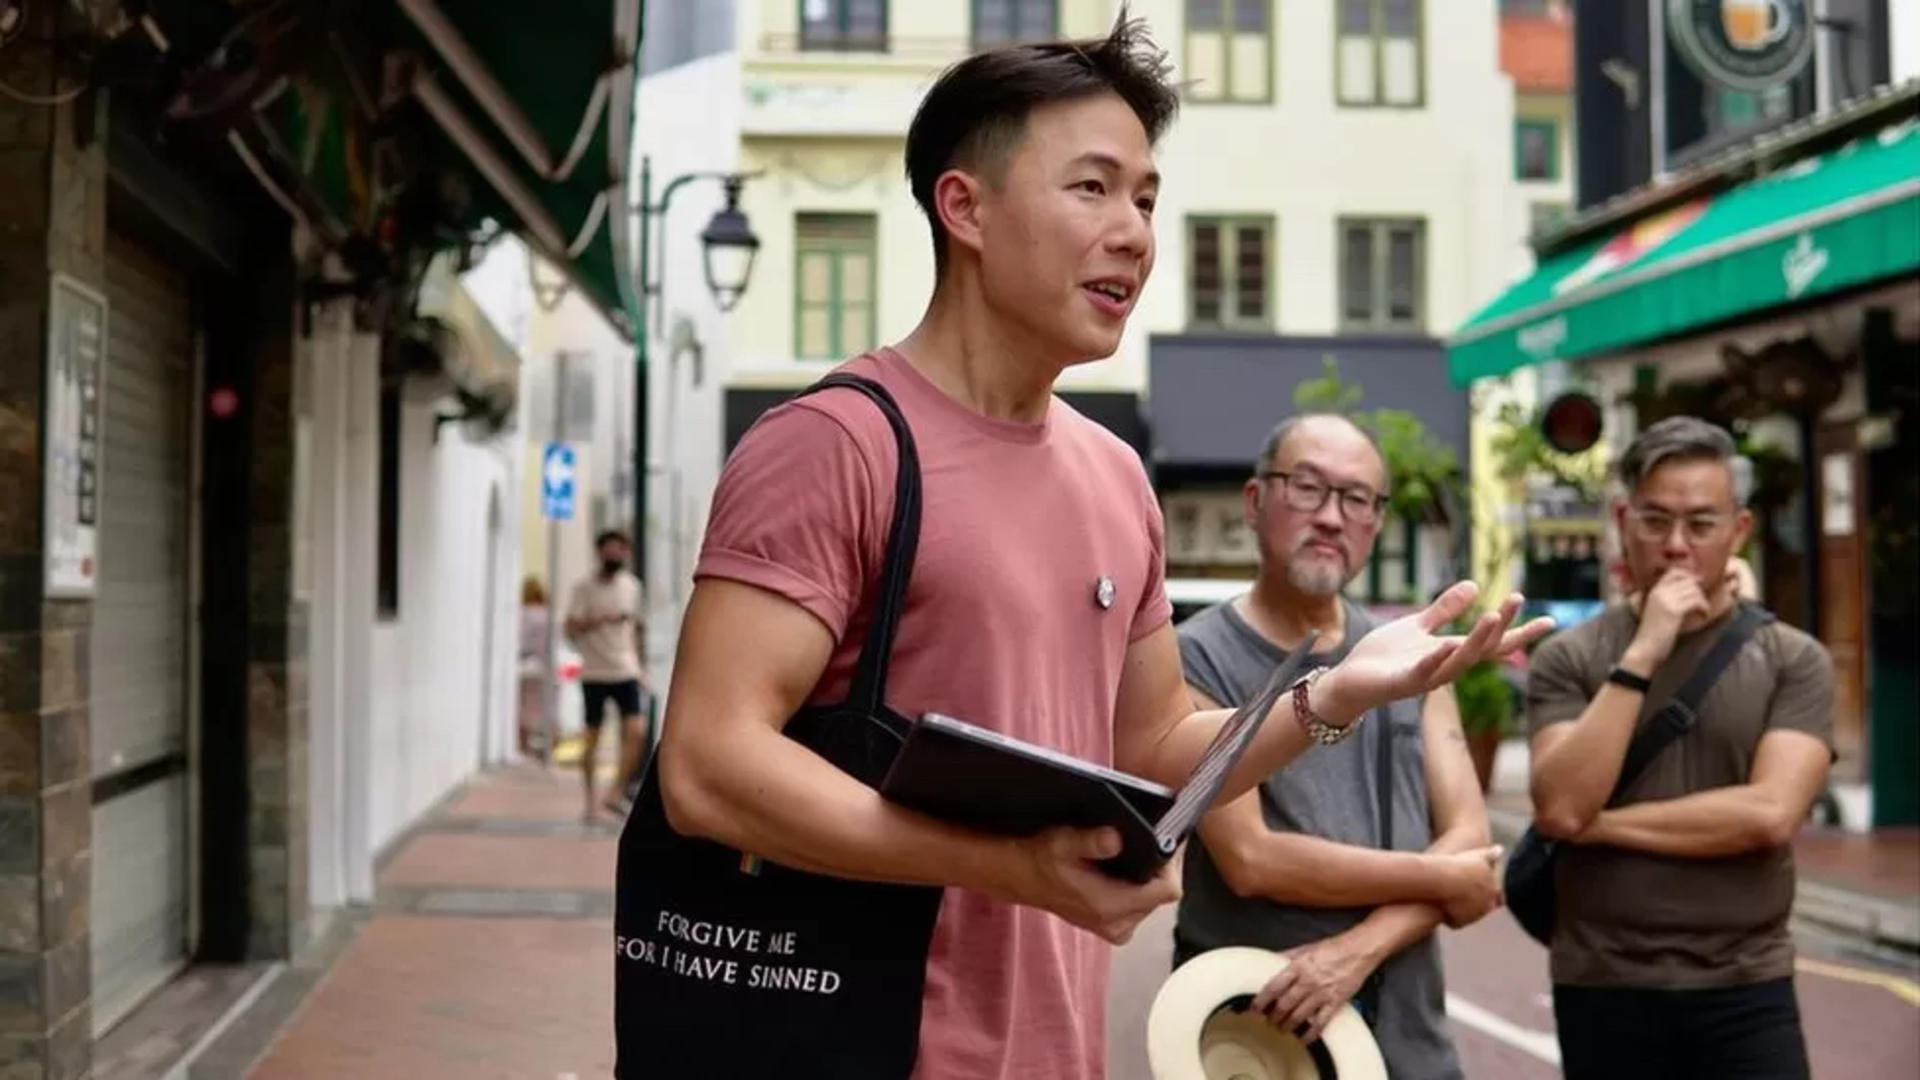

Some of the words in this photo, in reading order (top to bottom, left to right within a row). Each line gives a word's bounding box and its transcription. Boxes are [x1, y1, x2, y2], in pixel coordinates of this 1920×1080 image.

[657, 911, 760, 952] FORGIVE
[768, 931, 796, 955] ME
[616, 935, 655, 964] FOR
[661, 946, 669, 968] I
[674, 950, 738, 984] HAVE
[748, 964, 841, 994] SINNED
